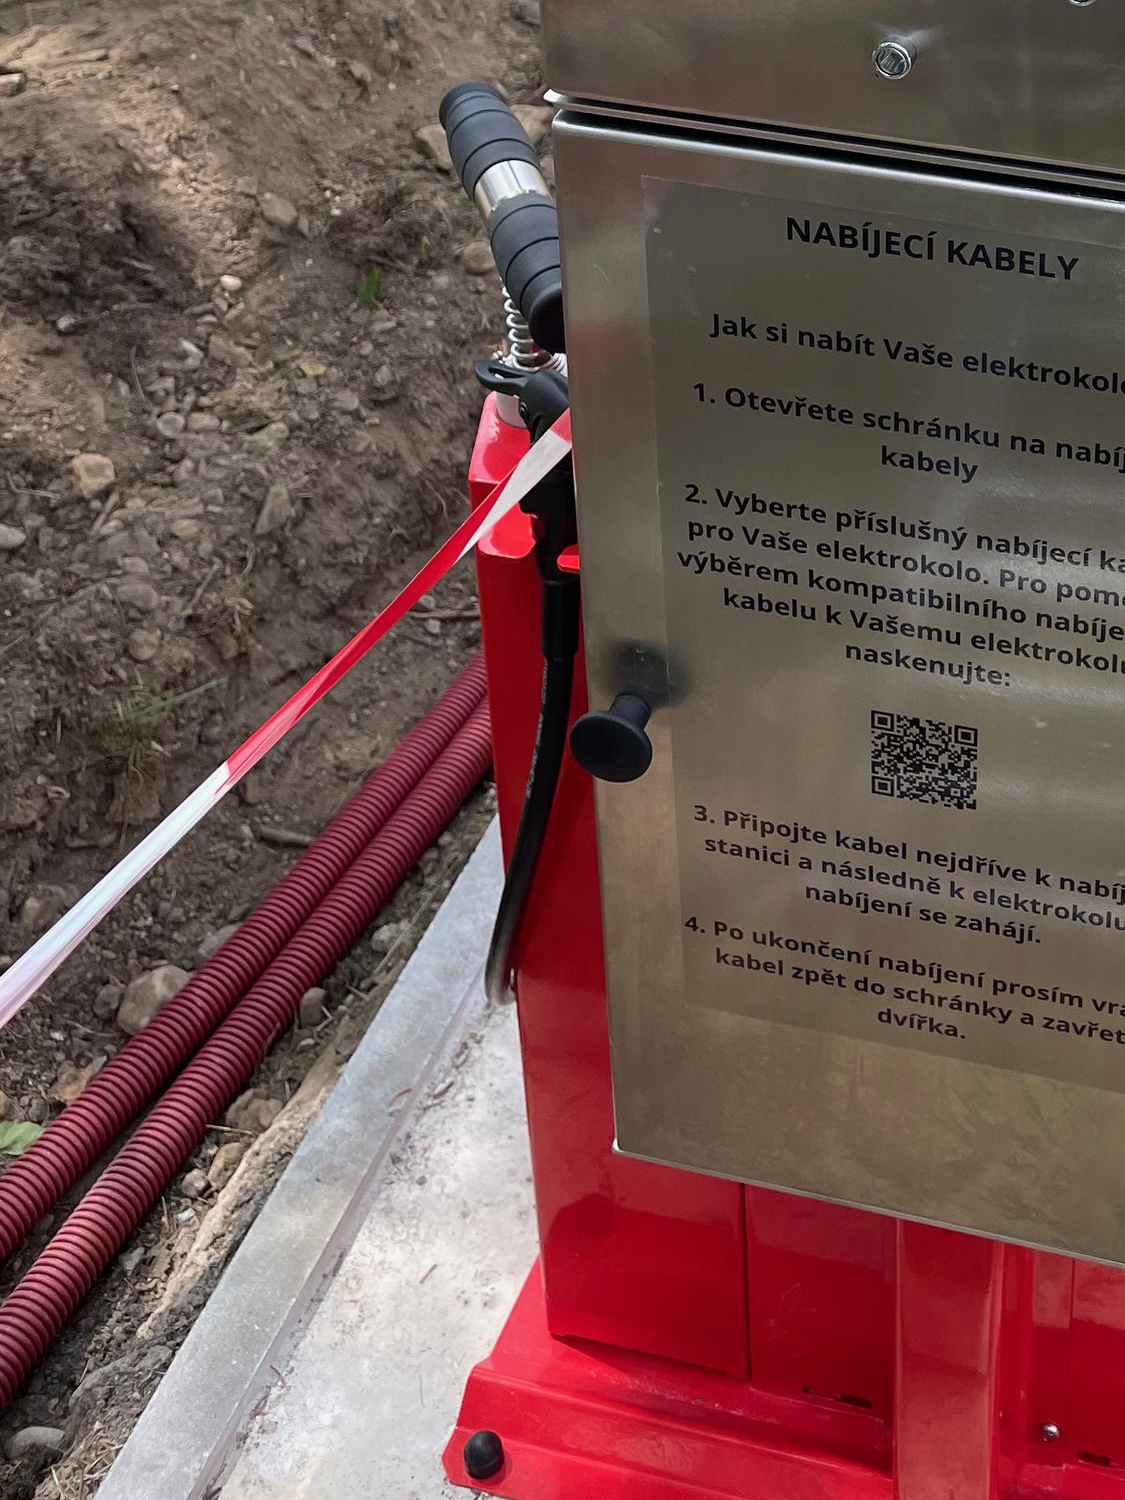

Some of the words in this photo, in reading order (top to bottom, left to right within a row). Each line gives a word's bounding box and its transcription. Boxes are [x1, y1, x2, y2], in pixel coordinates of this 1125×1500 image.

[786, 216, 937, 261] NABÍJECÍ
[947, 239, 1080, 281] KABELY
[709, 313, 758, 340] Jak
[765, 322, 788, 344] si
[797, 329, 876, 357] nabít
[882, 338, 954, 369] Vaše
[693, 382, 716, 404] 1.
[724, 387, 854, 425] Otevřete
[862, 411, 1000, 448] schránku
[1010, 434, 1046, 456] na
[881, 444, 979, 484] kabely
[684, 483, 708, 505] 2.
[714, 488, 827, 524] Vyberte
[836, 508, 968, 551] příslušný
[976, 534, 1093, 567] nabíjecí
[687, 520, 735, 542] pro
[741, 525, 808, 554] Vaše
[816, 539, 989, 585] elektrokolo.
[999, 568, 1047, 594] Pro
[676, 550, 799, 586] výběrem
[807, 568, 1027, 624] kompatibilního
[723, 587, 817, 621] kabelu
[825, 604, 843, 626] k
[848, 608, 961, 646] Vašemu
[845, 644, 1011, 687] naskenujte:
[693, 804, 715, 824] 3.
[723, 809, 827, 845] Připojte
[835, 829, 907, 860] kabel
[916, 849, 1027, 883] nejdříve
[1035, 867, 1052, 888] k
[704, 838, 790, 867] stanici
[798, 856, 813, 871] a
[821, 860, 941, 895] následně
[949, 880, 965, 901] k
[805, 886, 913, 918] nabíjení
[919, 908, 948, 925] se
[954, 914, 1041, 945] zahájí.
[684, 916, 706, 934] 4.
[713, 920, 744, 941] Po
[752, 930, 873, 966] ukončení
[878, 955, 986, 989] nabíjení
[992, 978, 1084, 1009] prosím
[715, 946, 784, 976] kabel
[791, 966, 847, 989] zpět
[853, 976, 886, 996] do
[892, 986, 1013, 1025] schránky
[1019, 1012, 1034, 1027] a
[877, 1007, 966, 1040] dvířka.
